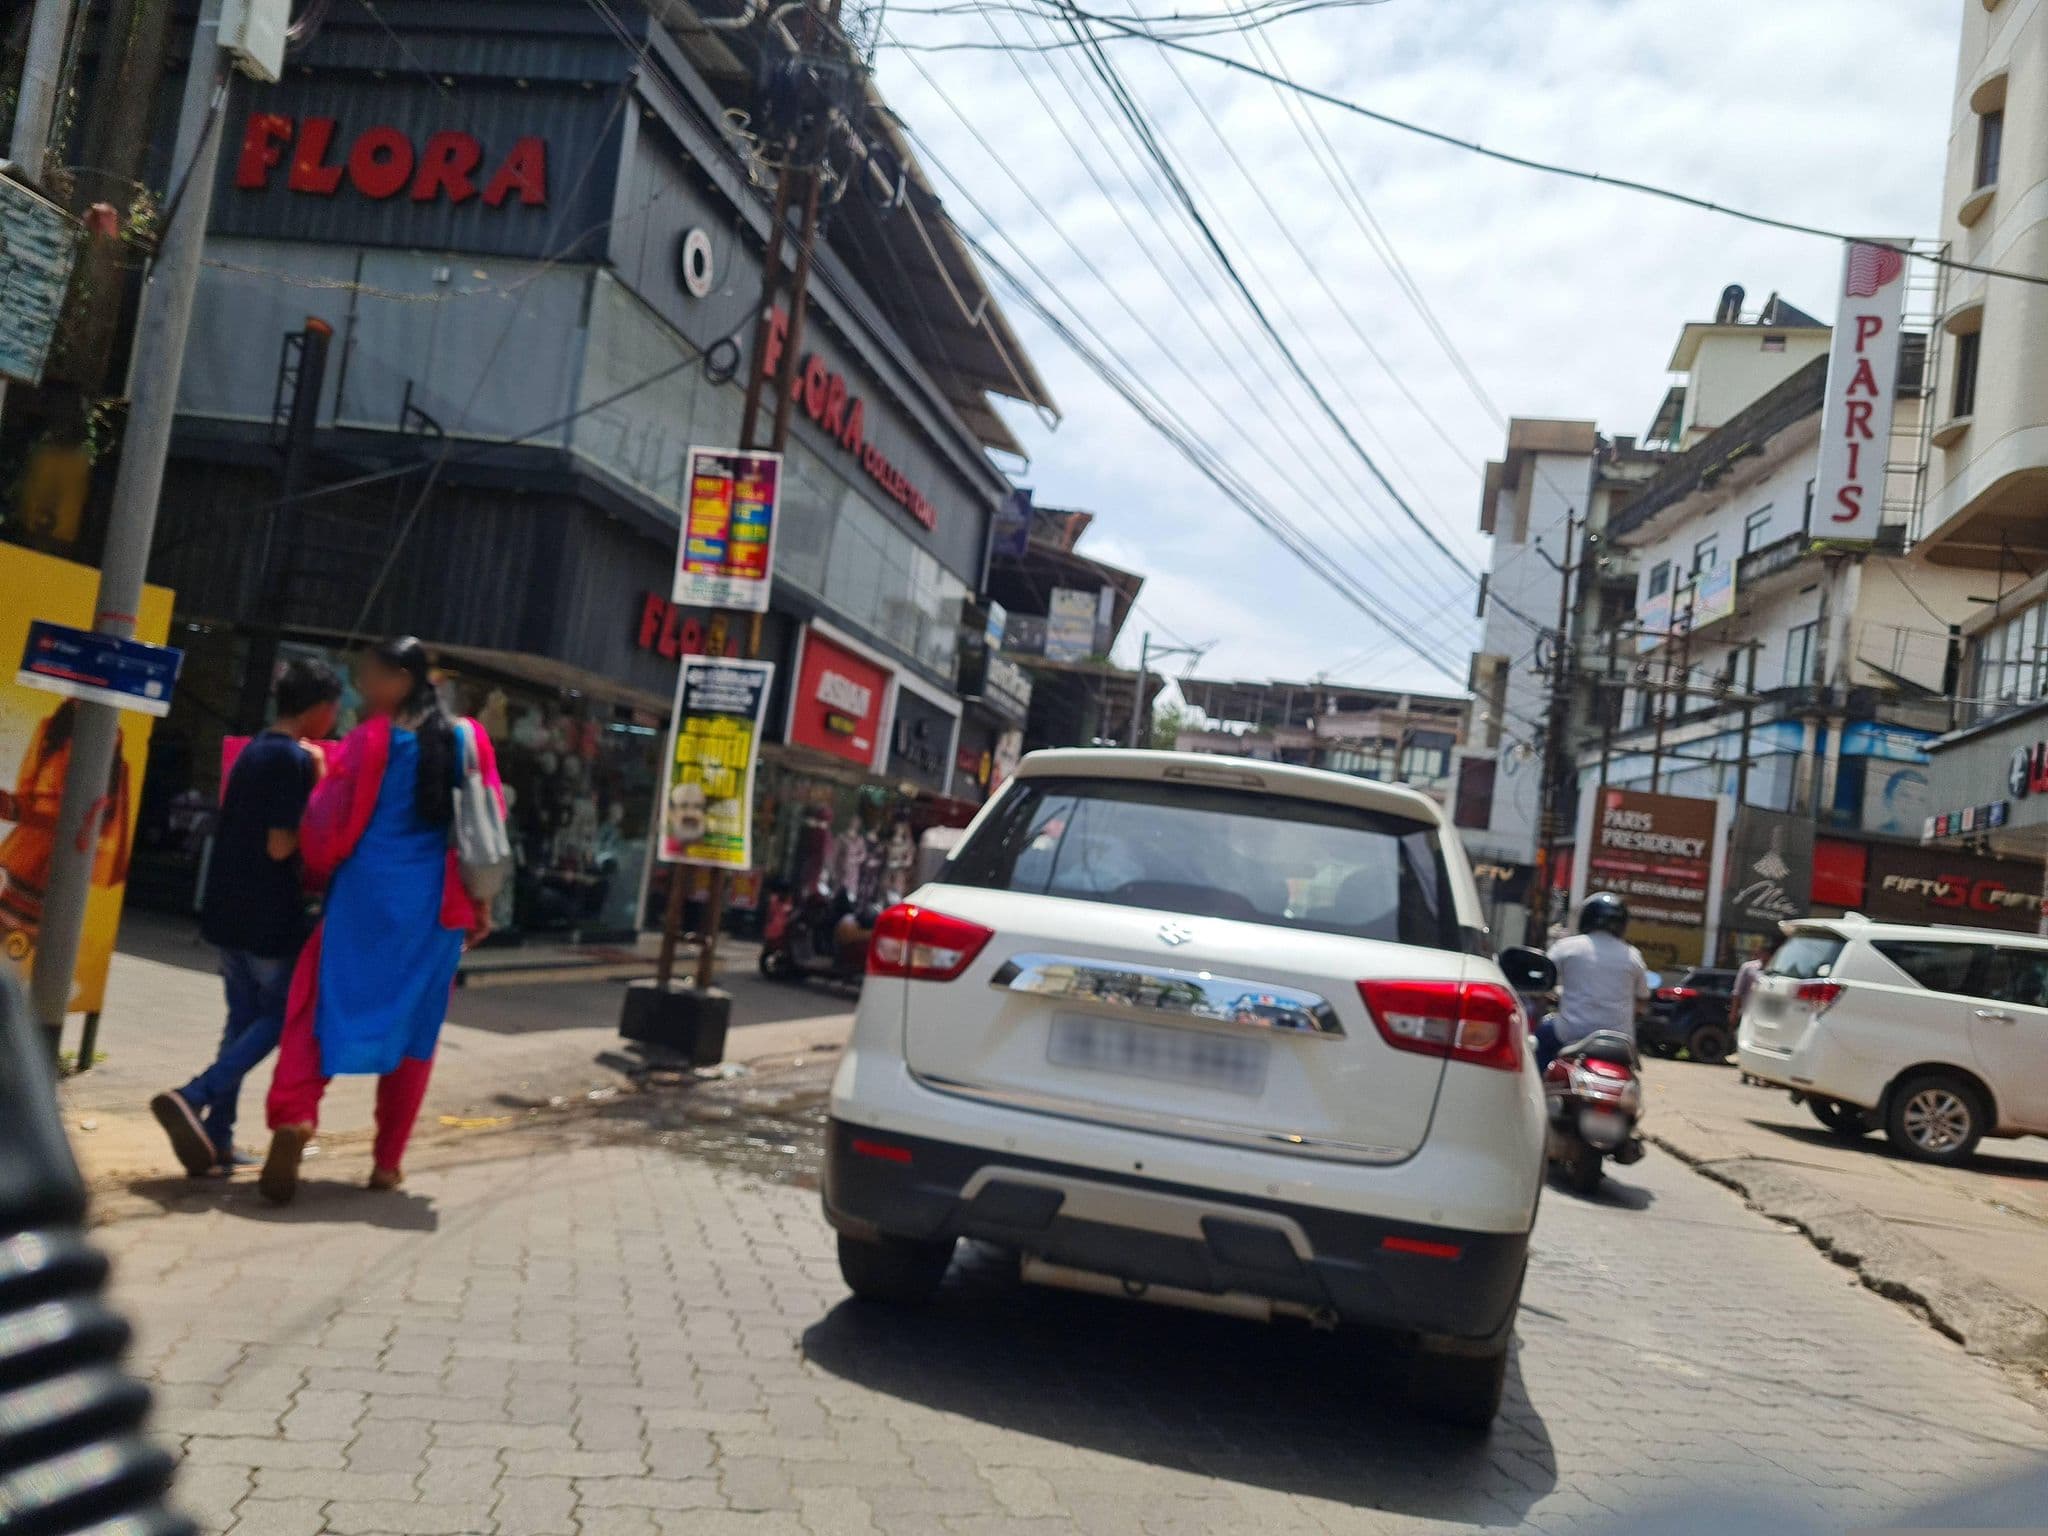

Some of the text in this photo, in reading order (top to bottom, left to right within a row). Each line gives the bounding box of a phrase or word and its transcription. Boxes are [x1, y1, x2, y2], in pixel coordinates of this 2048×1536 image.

[236, 112, 547, 207] FLORA
[762, 303, 865, 456] FORA
[1831, 315, 1884, 523] PARIS
[1602, 828, 1707, 858] PRESIDENCY
[1603, 809, 1653, 831] PARIS
[1882, 874, 1951, 897] FIFTY
